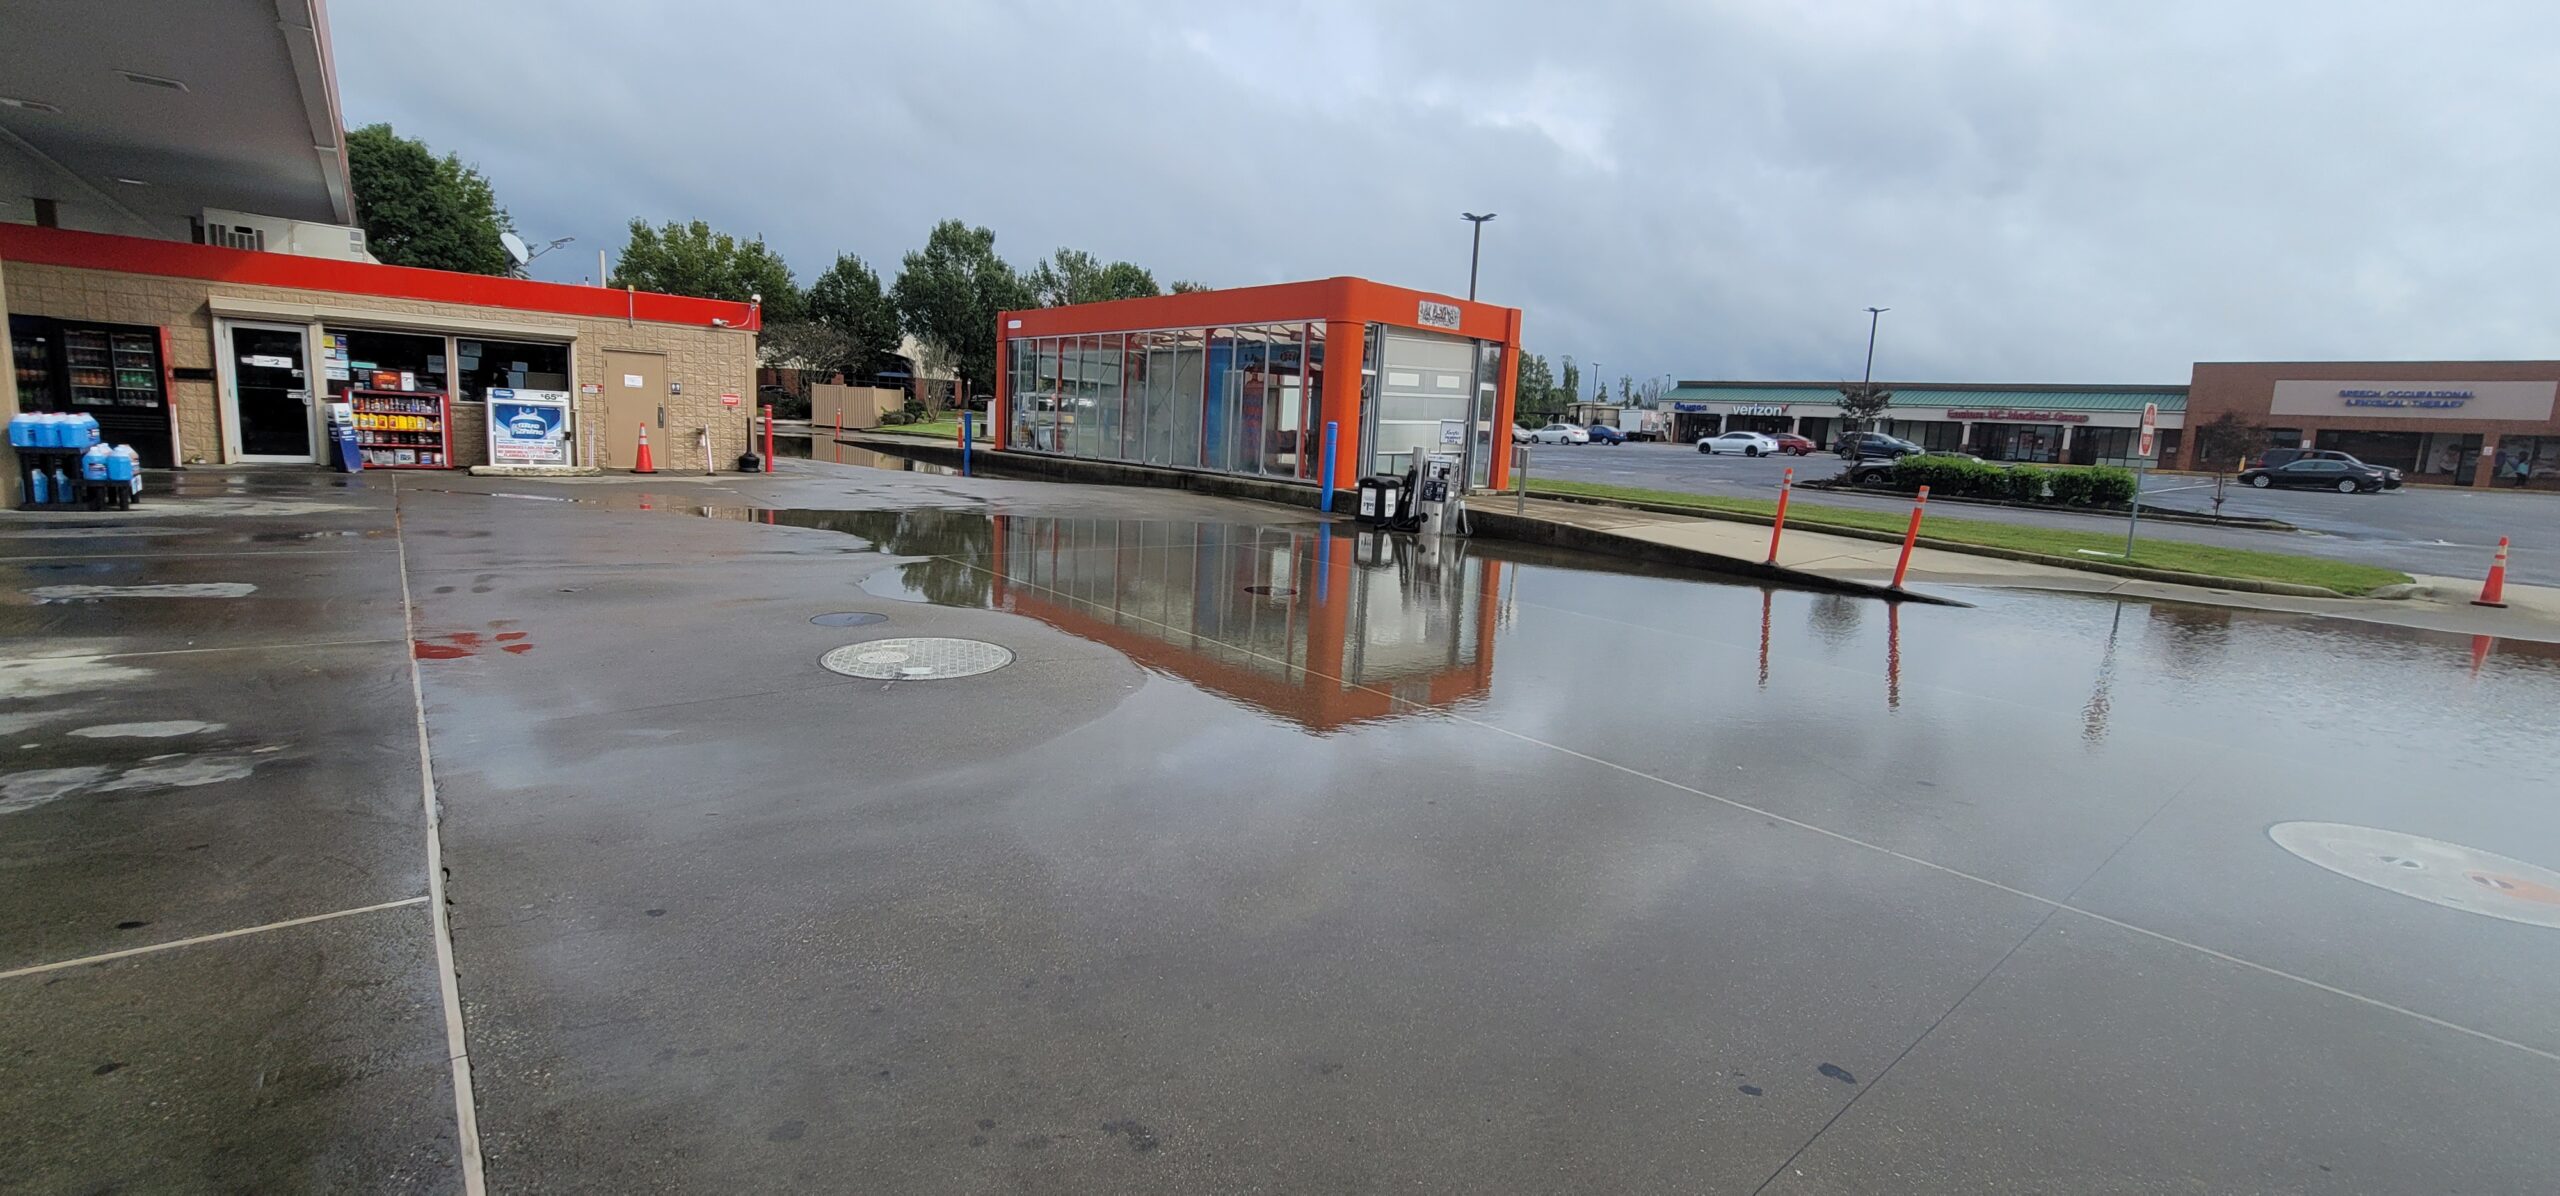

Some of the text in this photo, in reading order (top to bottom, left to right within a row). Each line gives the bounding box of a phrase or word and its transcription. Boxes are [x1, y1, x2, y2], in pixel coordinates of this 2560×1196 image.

[2386, 390, 2475, 399] OCCUPATIONAL
[1732, 403, 1783, 416] verizon
[2410, 400, 2465, 408] THERAPY
[2007, 409, 2052, 421] Medical
[2054, 411, 2090, 423] Group
